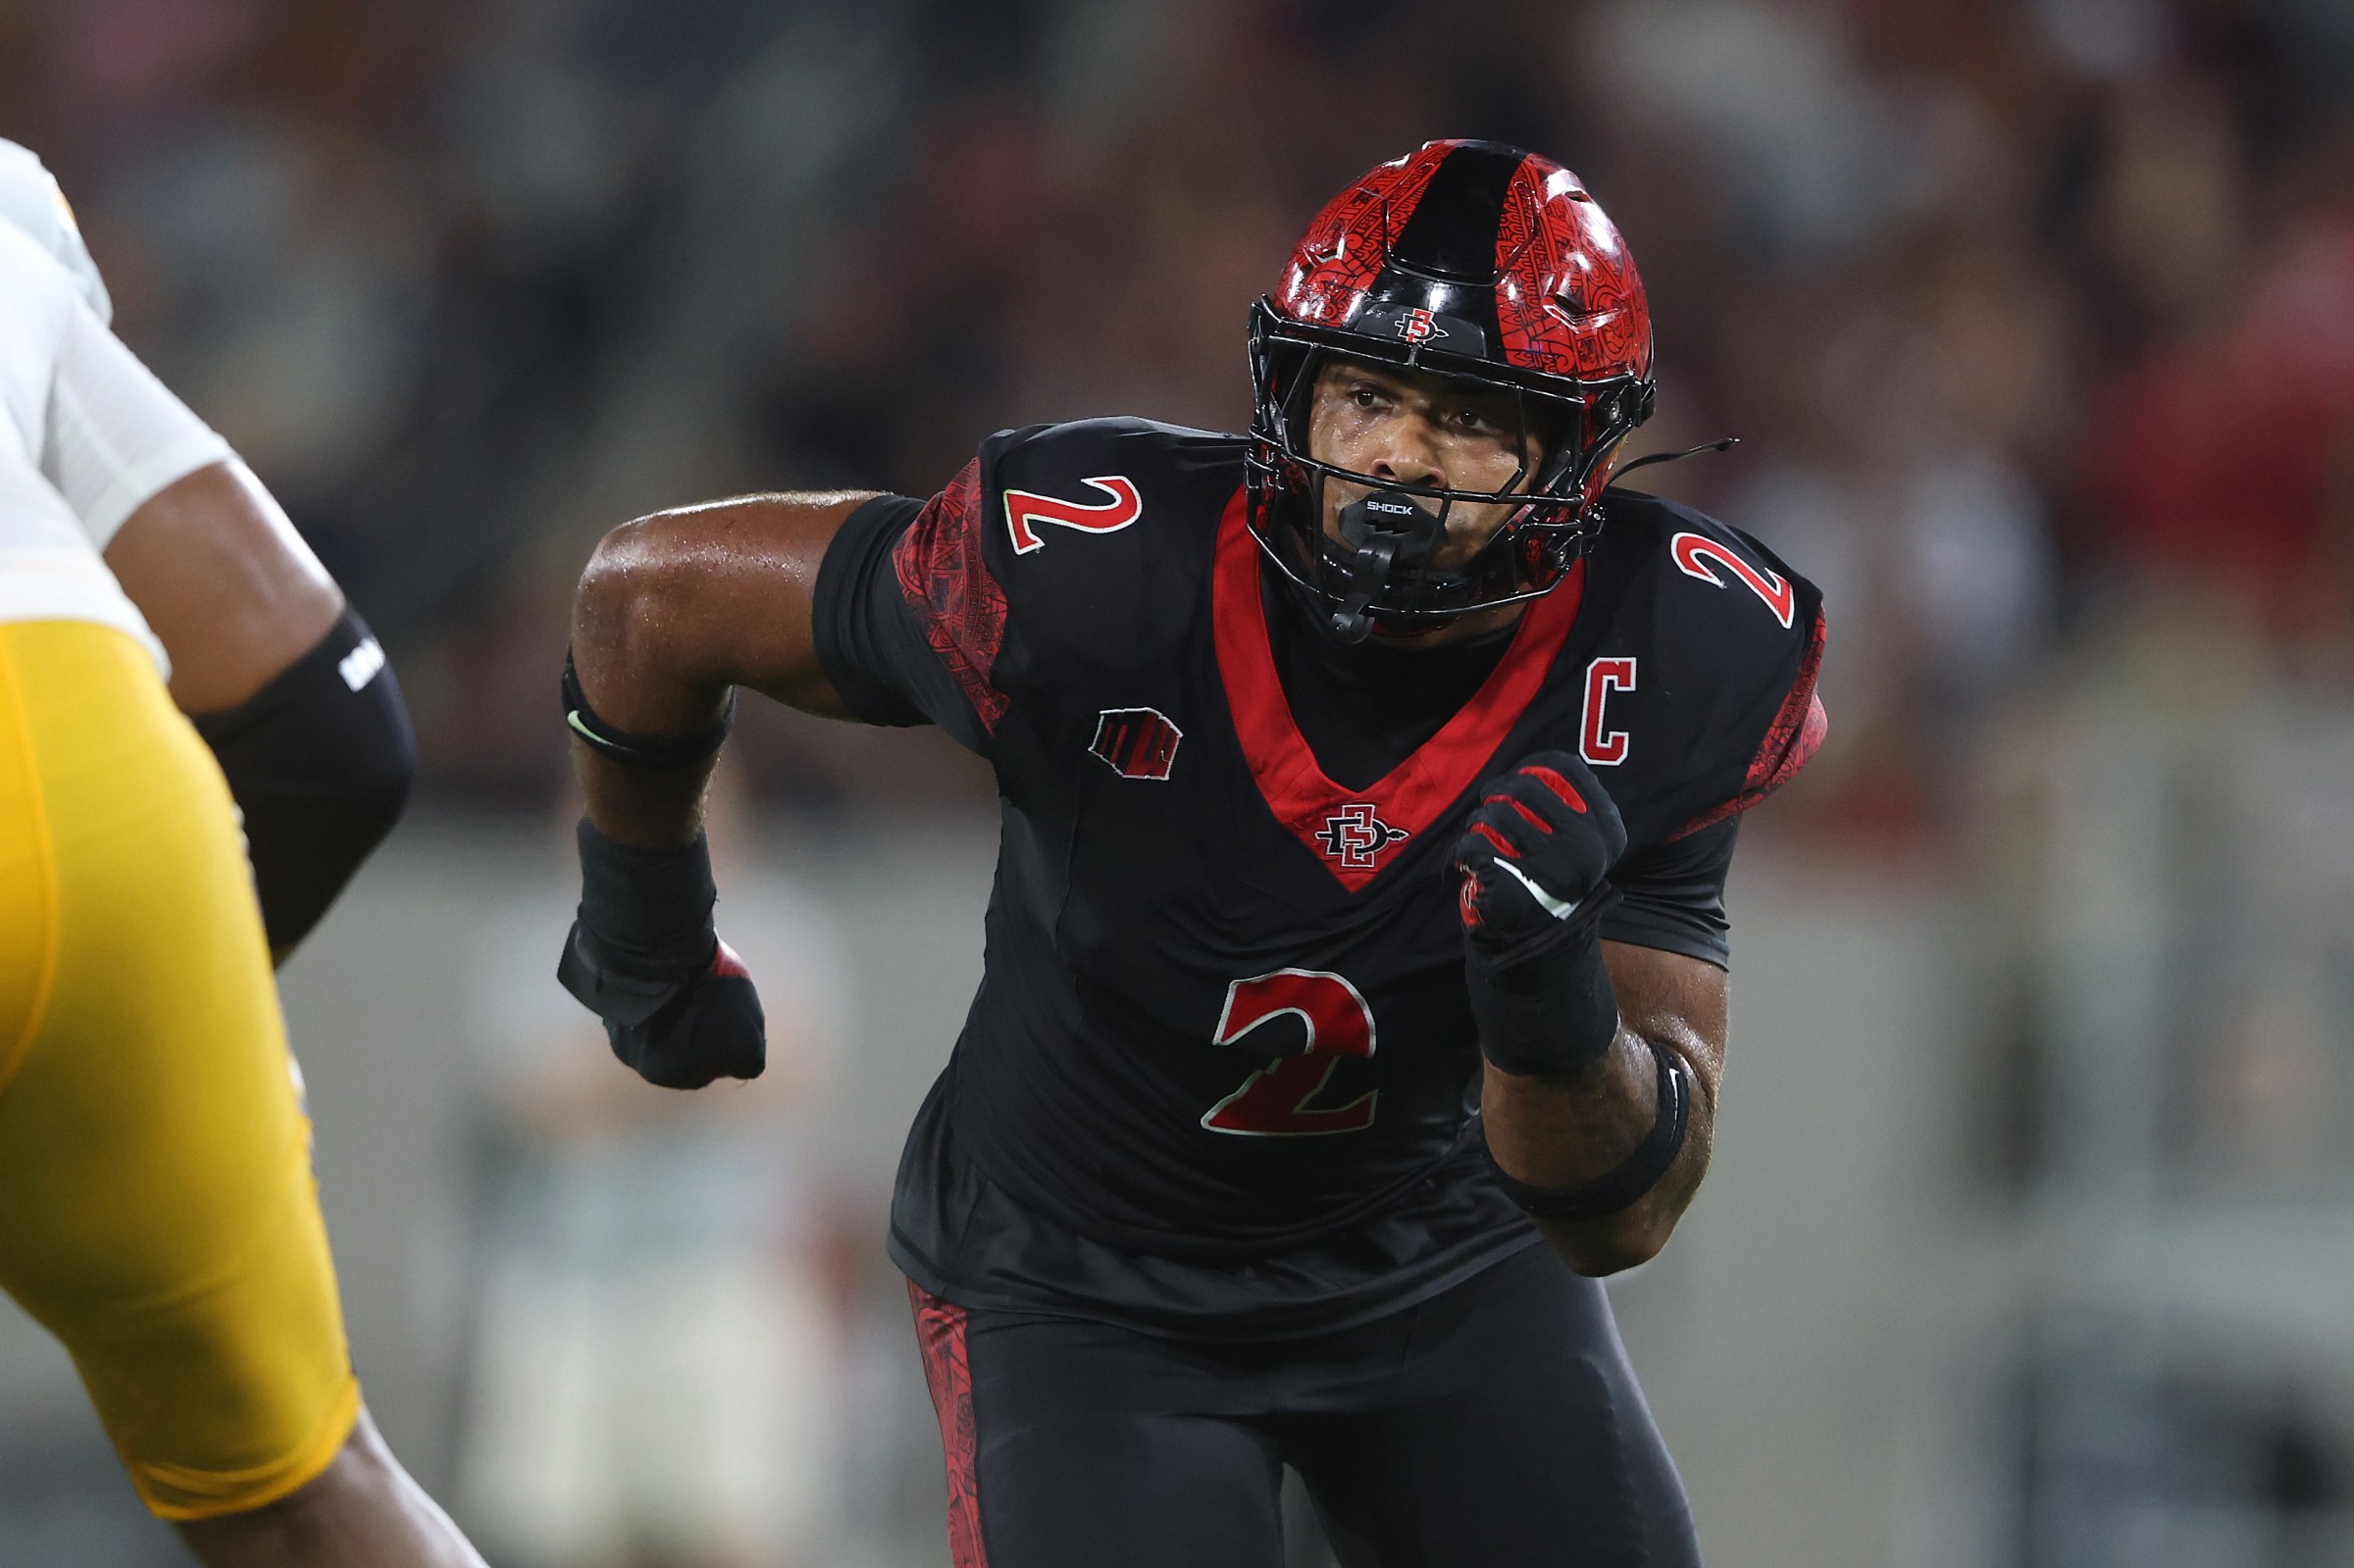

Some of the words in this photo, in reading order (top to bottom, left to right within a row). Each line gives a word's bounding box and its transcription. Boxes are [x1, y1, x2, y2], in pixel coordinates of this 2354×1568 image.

[1002, 475, 1143, 556] 2
[1366, 501, 1413, 516] SHOCK
[1669, 531, 1795, 630] 2
[1579, 656, 1637, 766] C
[1200, 967, 1379, 1137] 2
